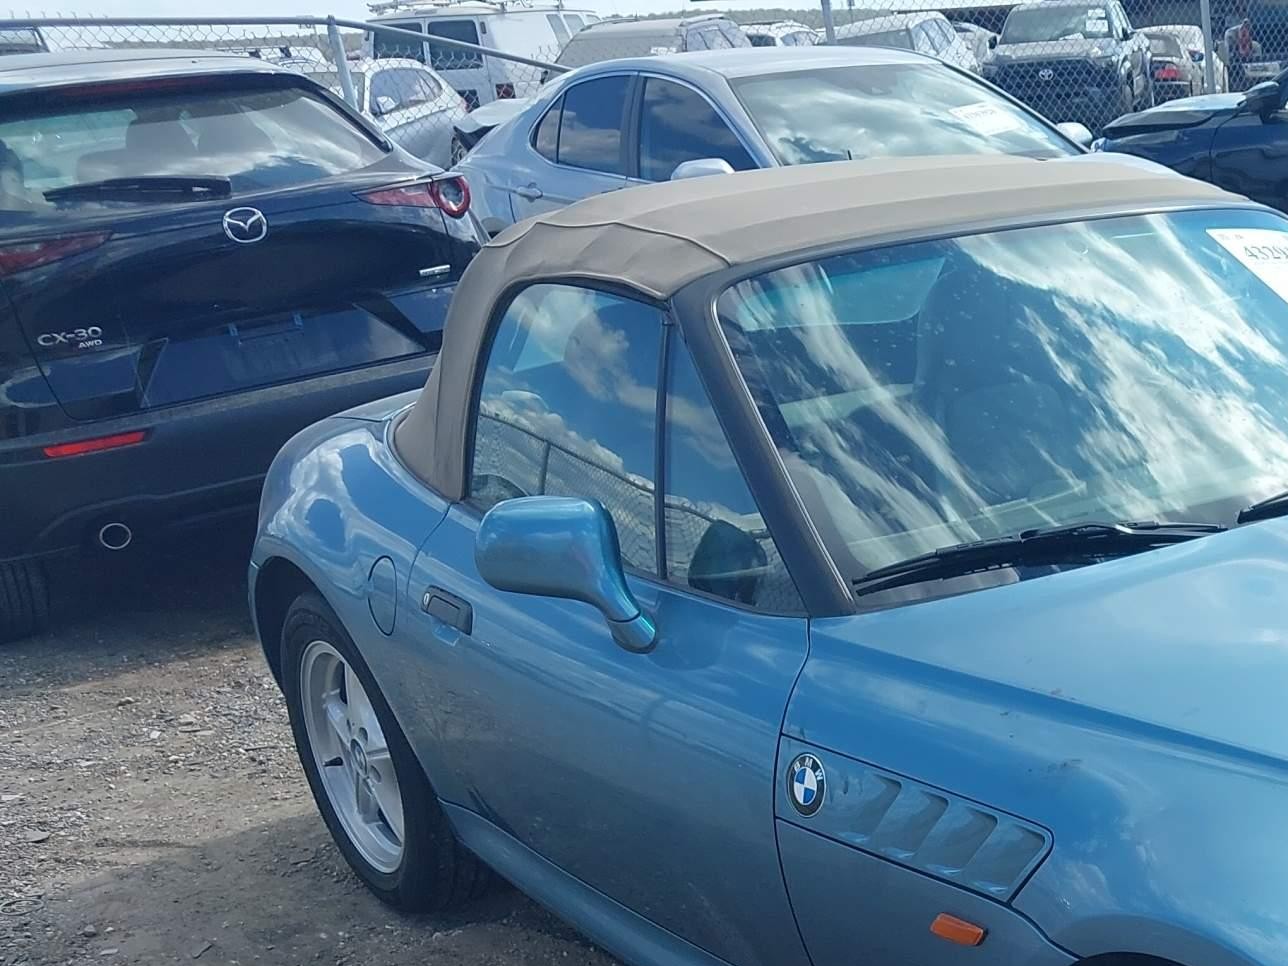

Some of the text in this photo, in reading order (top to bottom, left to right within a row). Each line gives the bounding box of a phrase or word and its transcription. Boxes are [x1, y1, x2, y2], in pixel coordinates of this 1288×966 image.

[37, 326, 103, 346] CX-30
[78, 339, 103, 349] AWD
[793, 756, 824, 781] BMW
